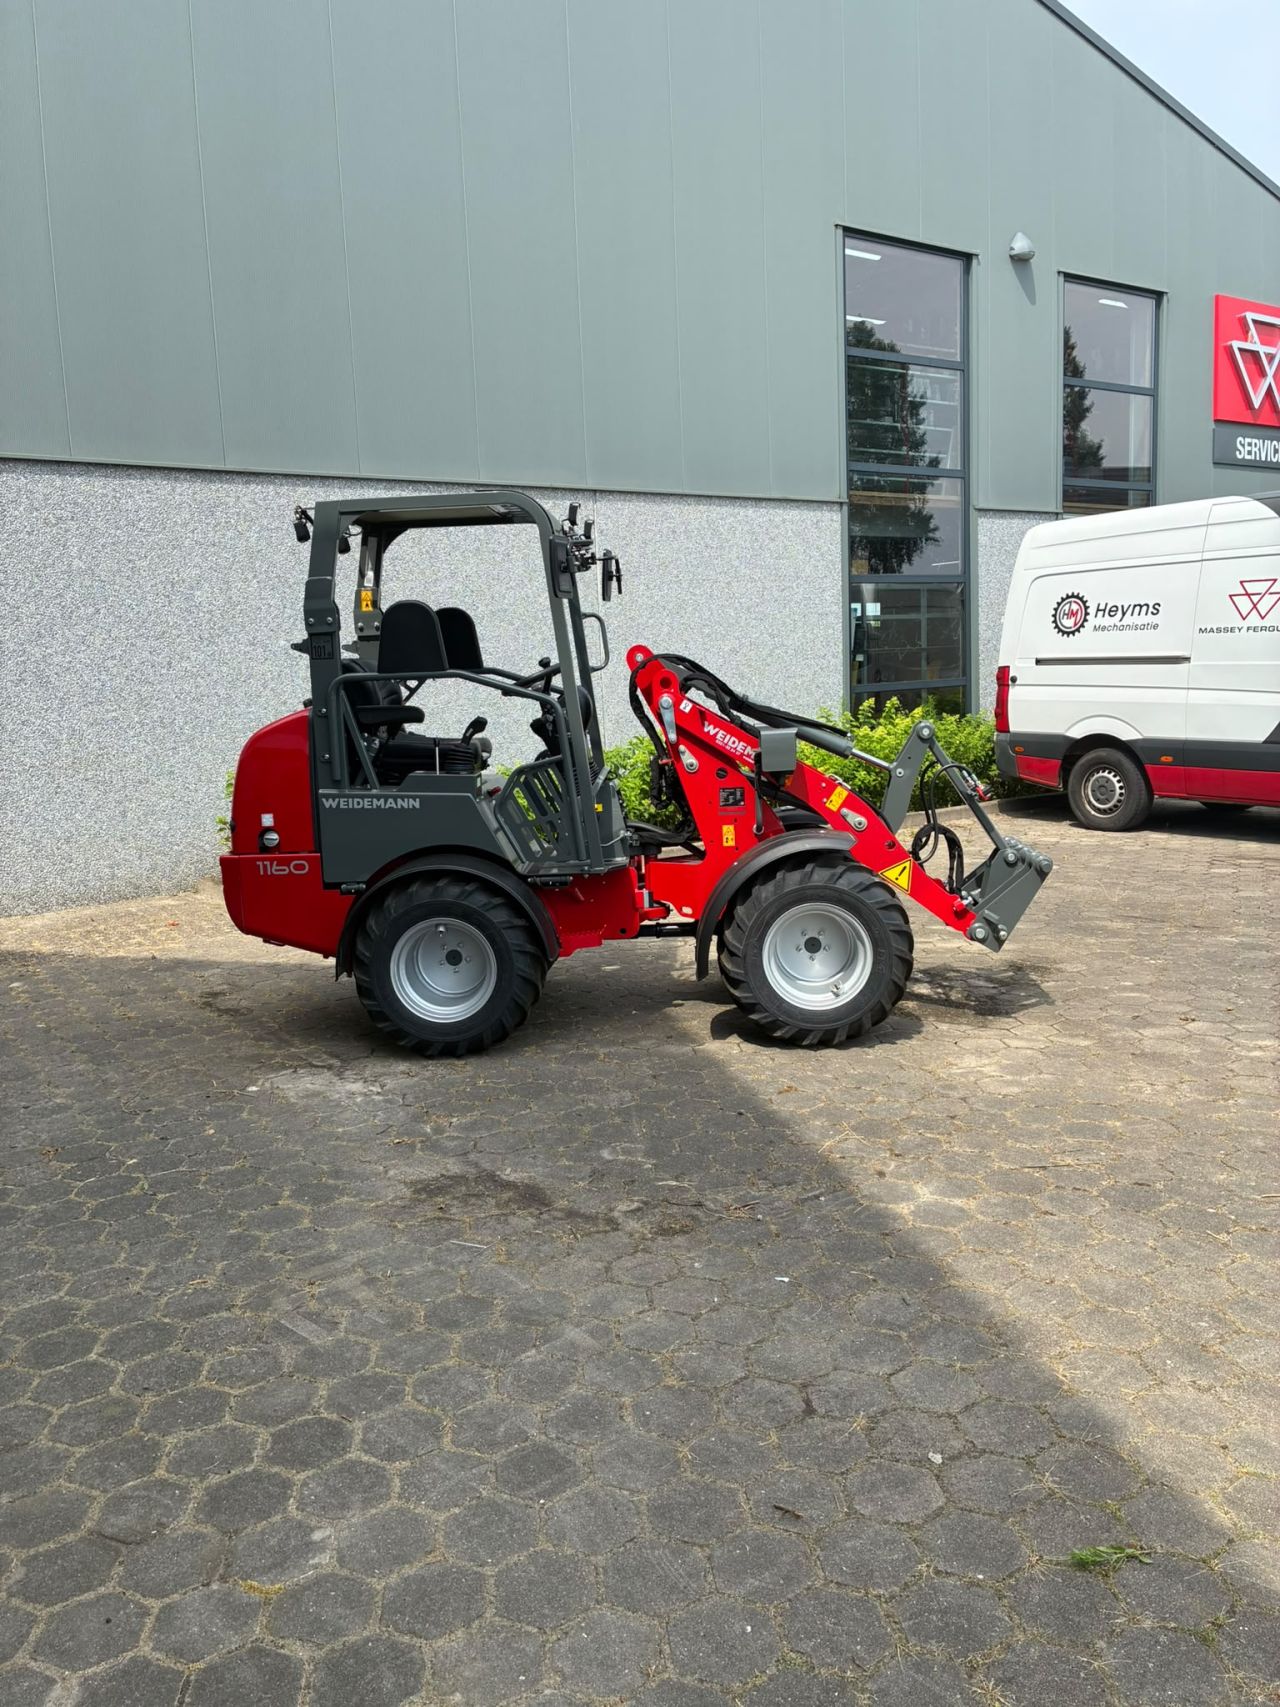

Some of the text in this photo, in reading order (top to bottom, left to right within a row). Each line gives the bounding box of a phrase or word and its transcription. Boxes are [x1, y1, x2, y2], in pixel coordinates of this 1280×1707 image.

[1235, 436, 1280, 462] SERVIC
[1094, 602, 1161, 622] Heyms
[1092, 621, 1159, 632] Mechanisatie
[1198, 626, 1244, 634] MASSEY
[703, 720, 756, 759] WEIDEM
[322, 798, 420, 809] WEIDEMANN
[256, 860, 309, 875] 1160
